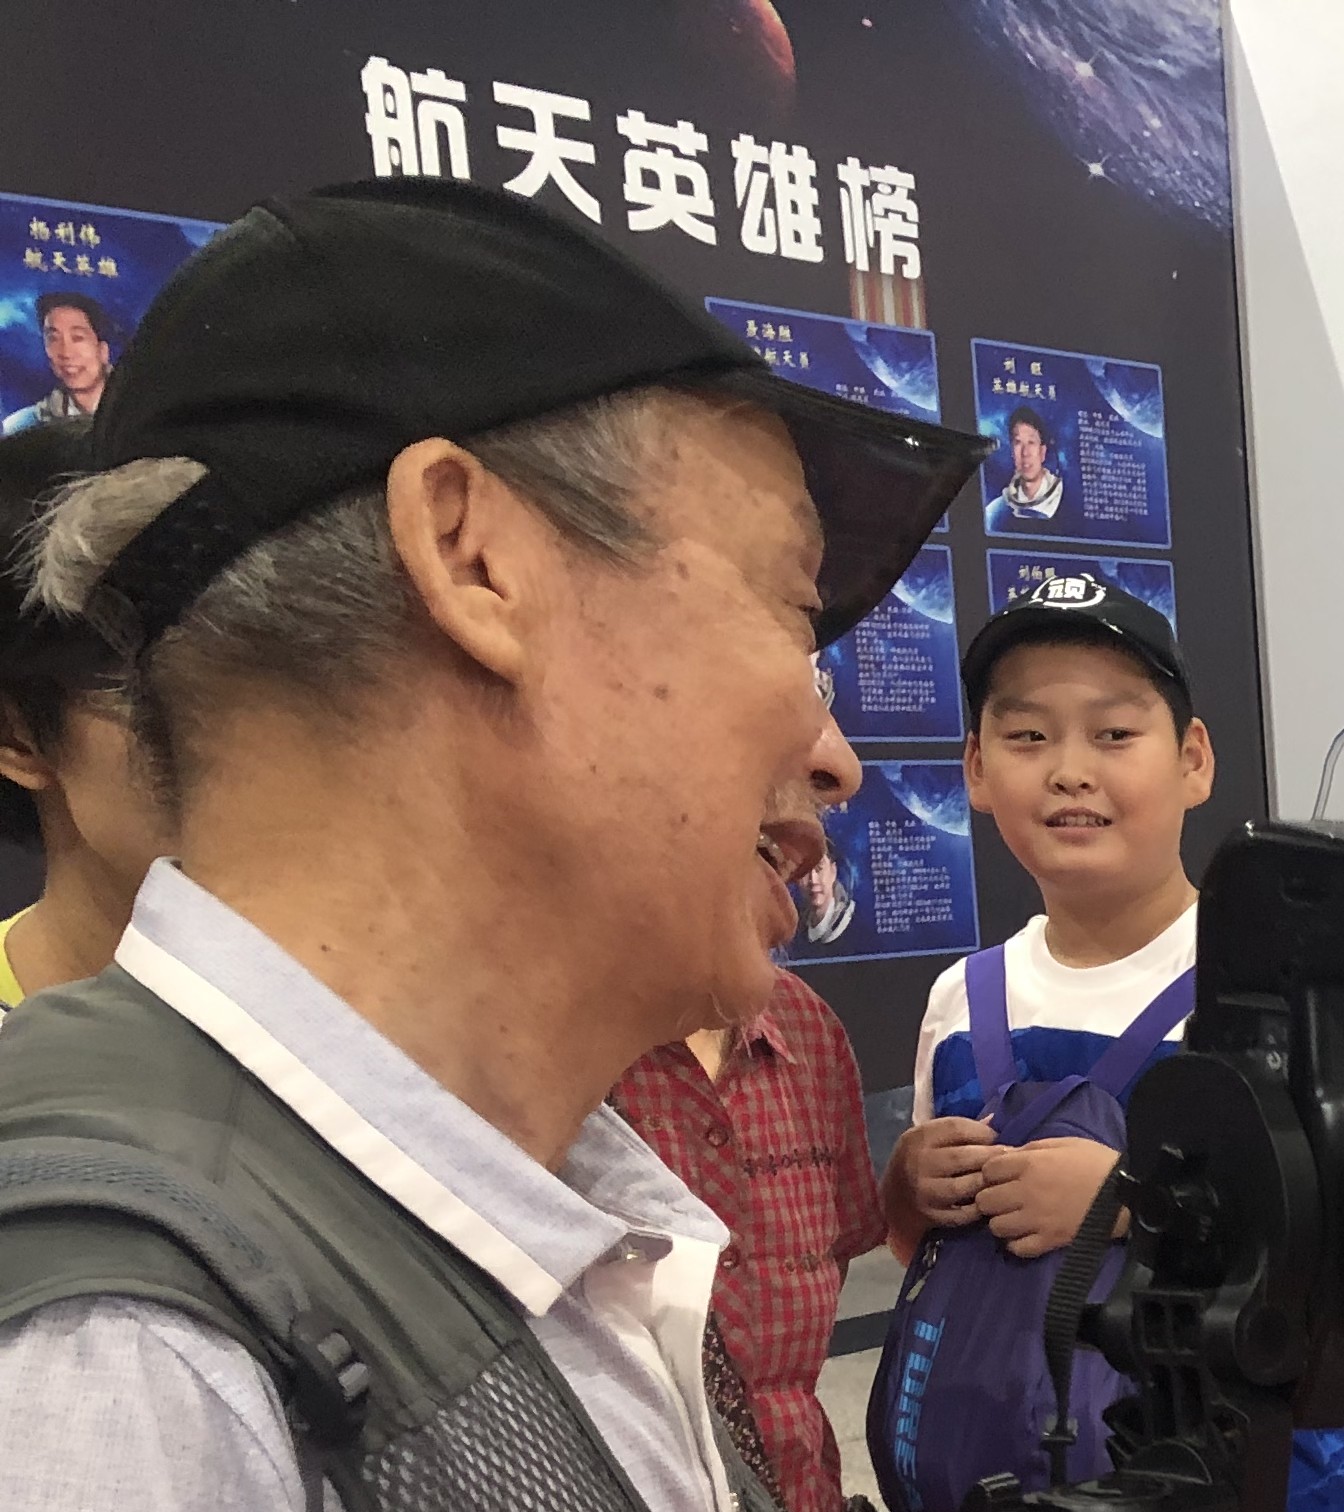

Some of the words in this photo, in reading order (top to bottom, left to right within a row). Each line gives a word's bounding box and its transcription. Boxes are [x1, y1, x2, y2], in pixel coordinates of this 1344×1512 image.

[360, 55, 921, 281] 航天英雄榜
